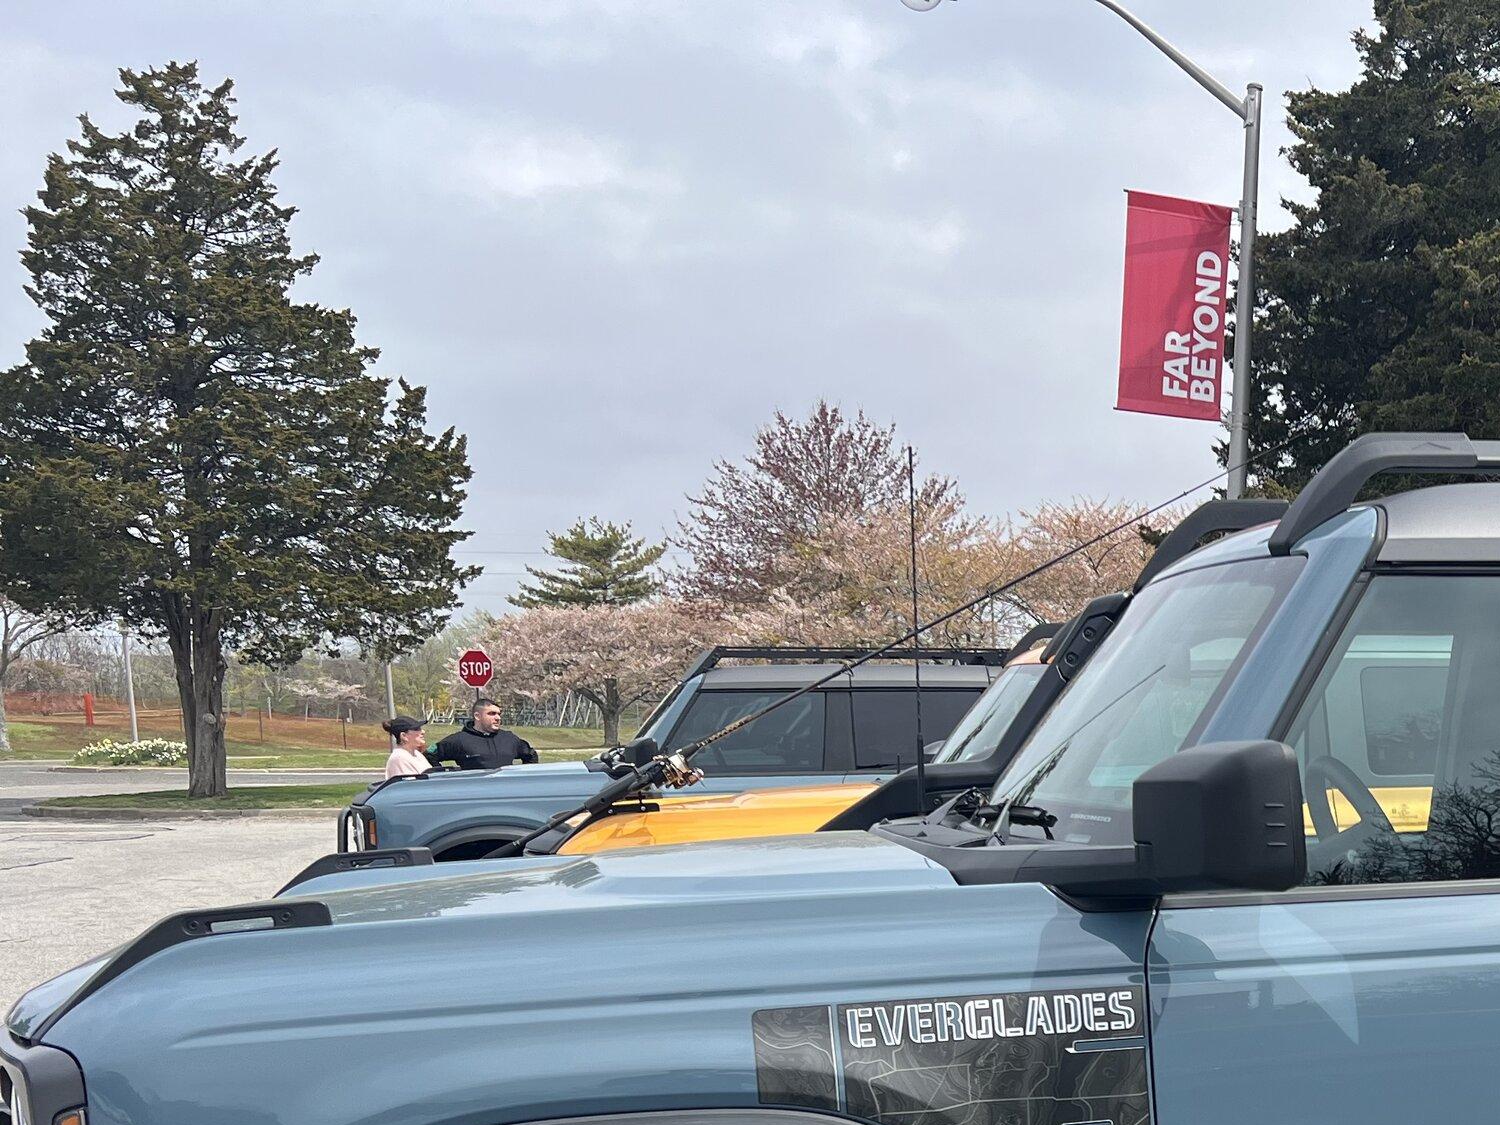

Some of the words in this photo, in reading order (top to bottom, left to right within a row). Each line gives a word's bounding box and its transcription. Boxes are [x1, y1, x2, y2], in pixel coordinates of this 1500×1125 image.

[1189, 250, 1222, 403] BEYOND
[1162, 330, 1190, 399] FAR
[461, 661, 491, 676] STOP
[845, 991, 1136, 1049] EVERGLADES
